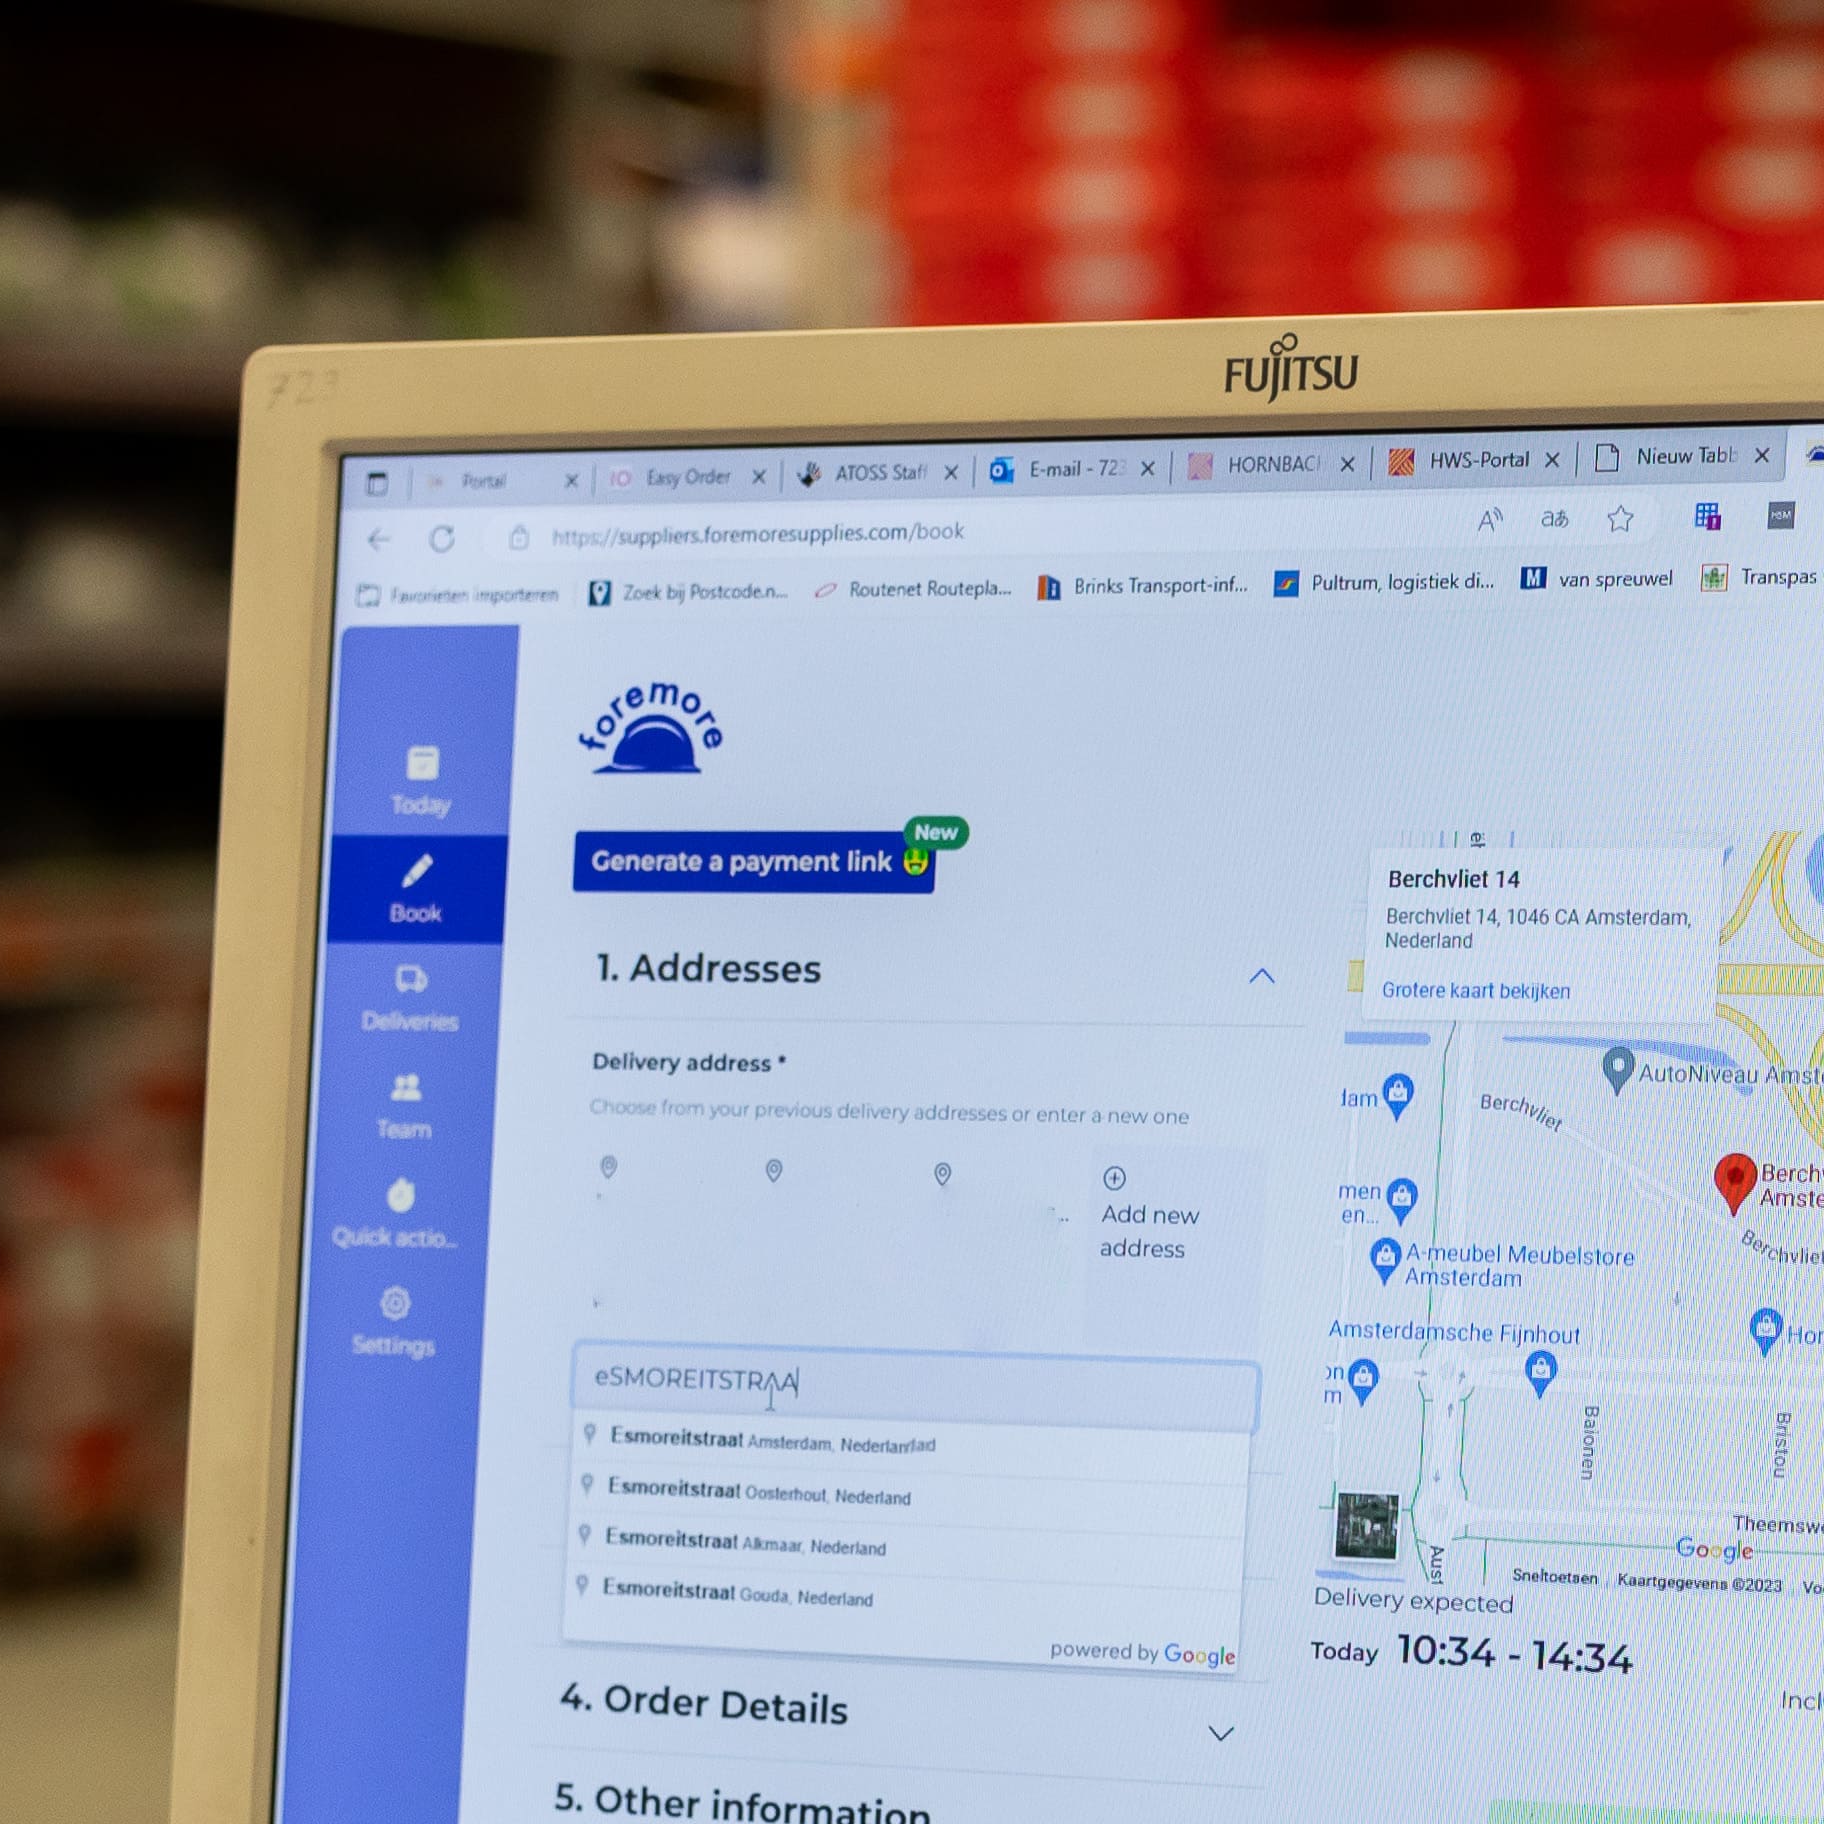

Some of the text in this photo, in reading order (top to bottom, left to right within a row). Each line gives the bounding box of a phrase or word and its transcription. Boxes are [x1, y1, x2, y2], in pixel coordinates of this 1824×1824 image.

[1224, 332, 1359, 404] FUJITSU
[1430, 450, 1530, 469] HWS-Portal
[1637, 447, 1694, 465] Nieuw
[553, 521, 965, 550] https://suppliers.foremoresupplies.com/book
[849, 580, 922, 598] Routenet
[1075, 578, 1124, 595] Brinks
[1312, 572, 1460, 593] Pultrum, logistiek
[1559, 569, 1674, 593] van spreuwel
[1741, 567, 1818, 589] Transpas
[578, 681, 724, 752] foremore
[914, 823, 959, 841] New
[591, 849, 893, 877] Generate a payment link
[1388, 868, 1520, 889] Berchvliet 14
[389, 902, 442, 923] Book
[1386, 907, 1692, 929] Berchvliet 14, 1046 CA Amsterdam,
[1385, 931, 1474, 949] Nederland
[597, 952, 822, 984] 1. Addresses
[1382, 981, 1571, 1003] Grotere kaart bekijken
[592, 1051, 772, 1076] Delivery address
[1480, 1093, 1563, 1133] Berchvliet
[1101, 1204, 1200, 1225] Add new
[1100, 1237, 1186, 1259] address
[1406, 1243, 1635, 1267] A-meubel Meubelstore
[1405, 1267, 1522, 1288] Amsterdam
[1328, 1320, 1580, 1346] Amsterdamsche Fijnhout
[611, 1425, 744, 1448] Esmoreitstraat
[1314, 1586, 1514, 1616] Delivery expected
[1050, 1639, 1238, 1670] powered by Google
[1310, 1633, 1634, 1675] Today 10:34 14:34
[560, 1682, 848, 1726] 4. Order Details
[554, 1782, 583, 1812] 5.
[595, 1785, 701, 1819] Other
